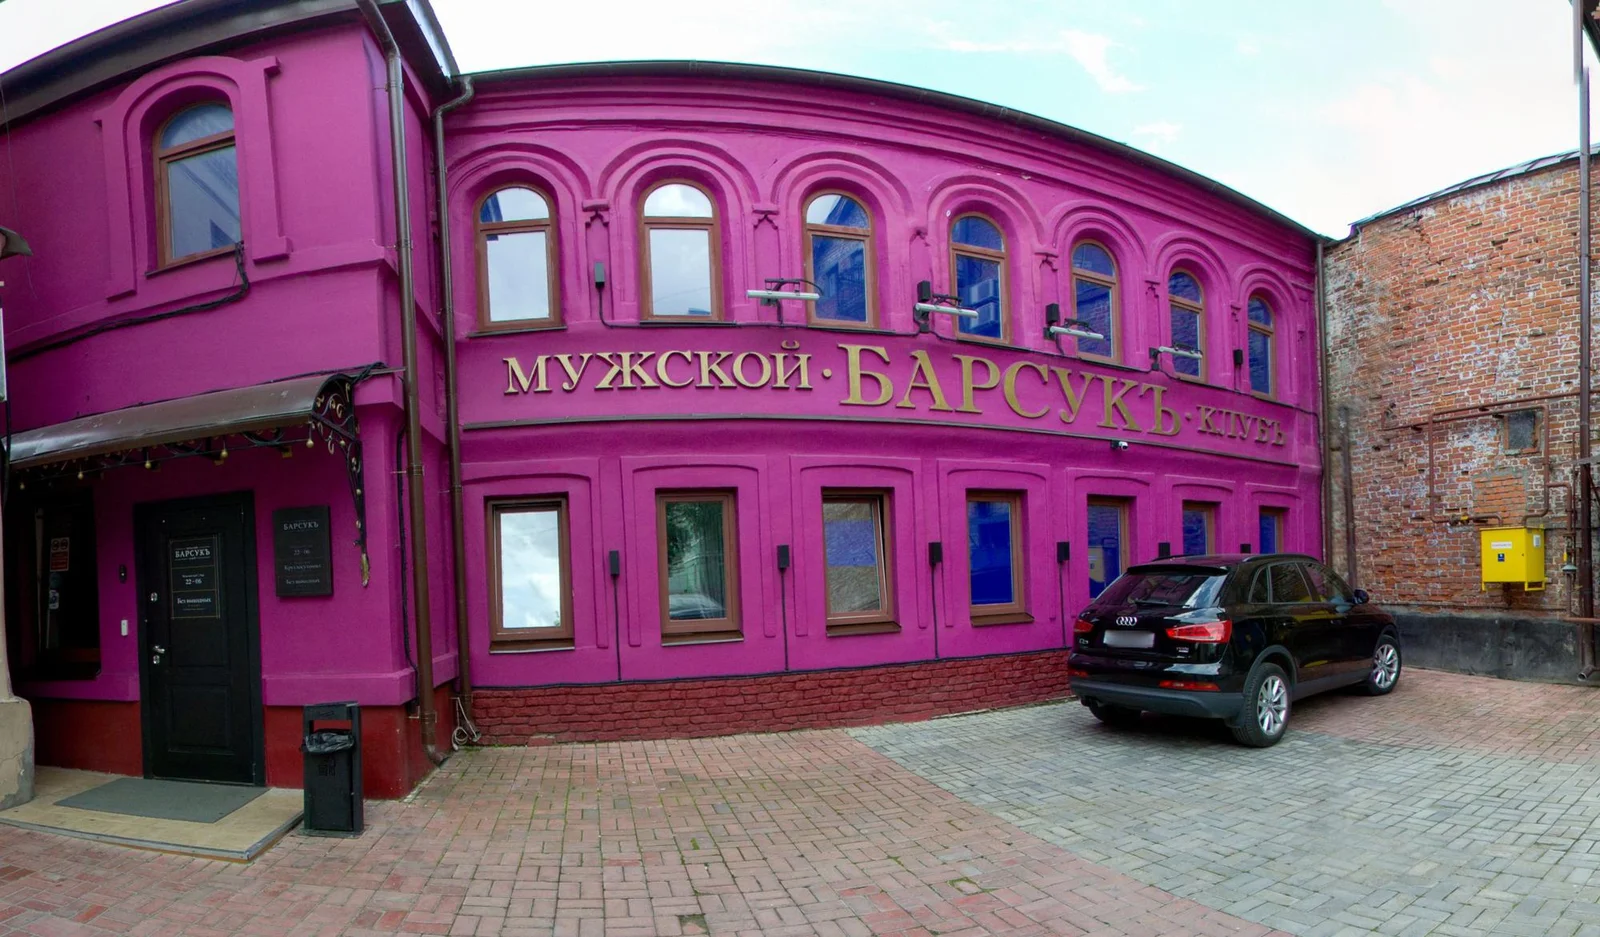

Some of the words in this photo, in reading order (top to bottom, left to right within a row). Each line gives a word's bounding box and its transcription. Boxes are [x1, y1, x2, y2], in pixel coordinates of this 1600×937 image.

[503, 340, 813, 395] МУЖСКОЙ
[837, 344, 1182, 437] БАРСУКЪ
[1196, 405, 1287, 446] КЛУБЪ
[283, 521, 319, 531] БАРСУКЪ
[175, 548, 211, 558] БАРСУКЪ
